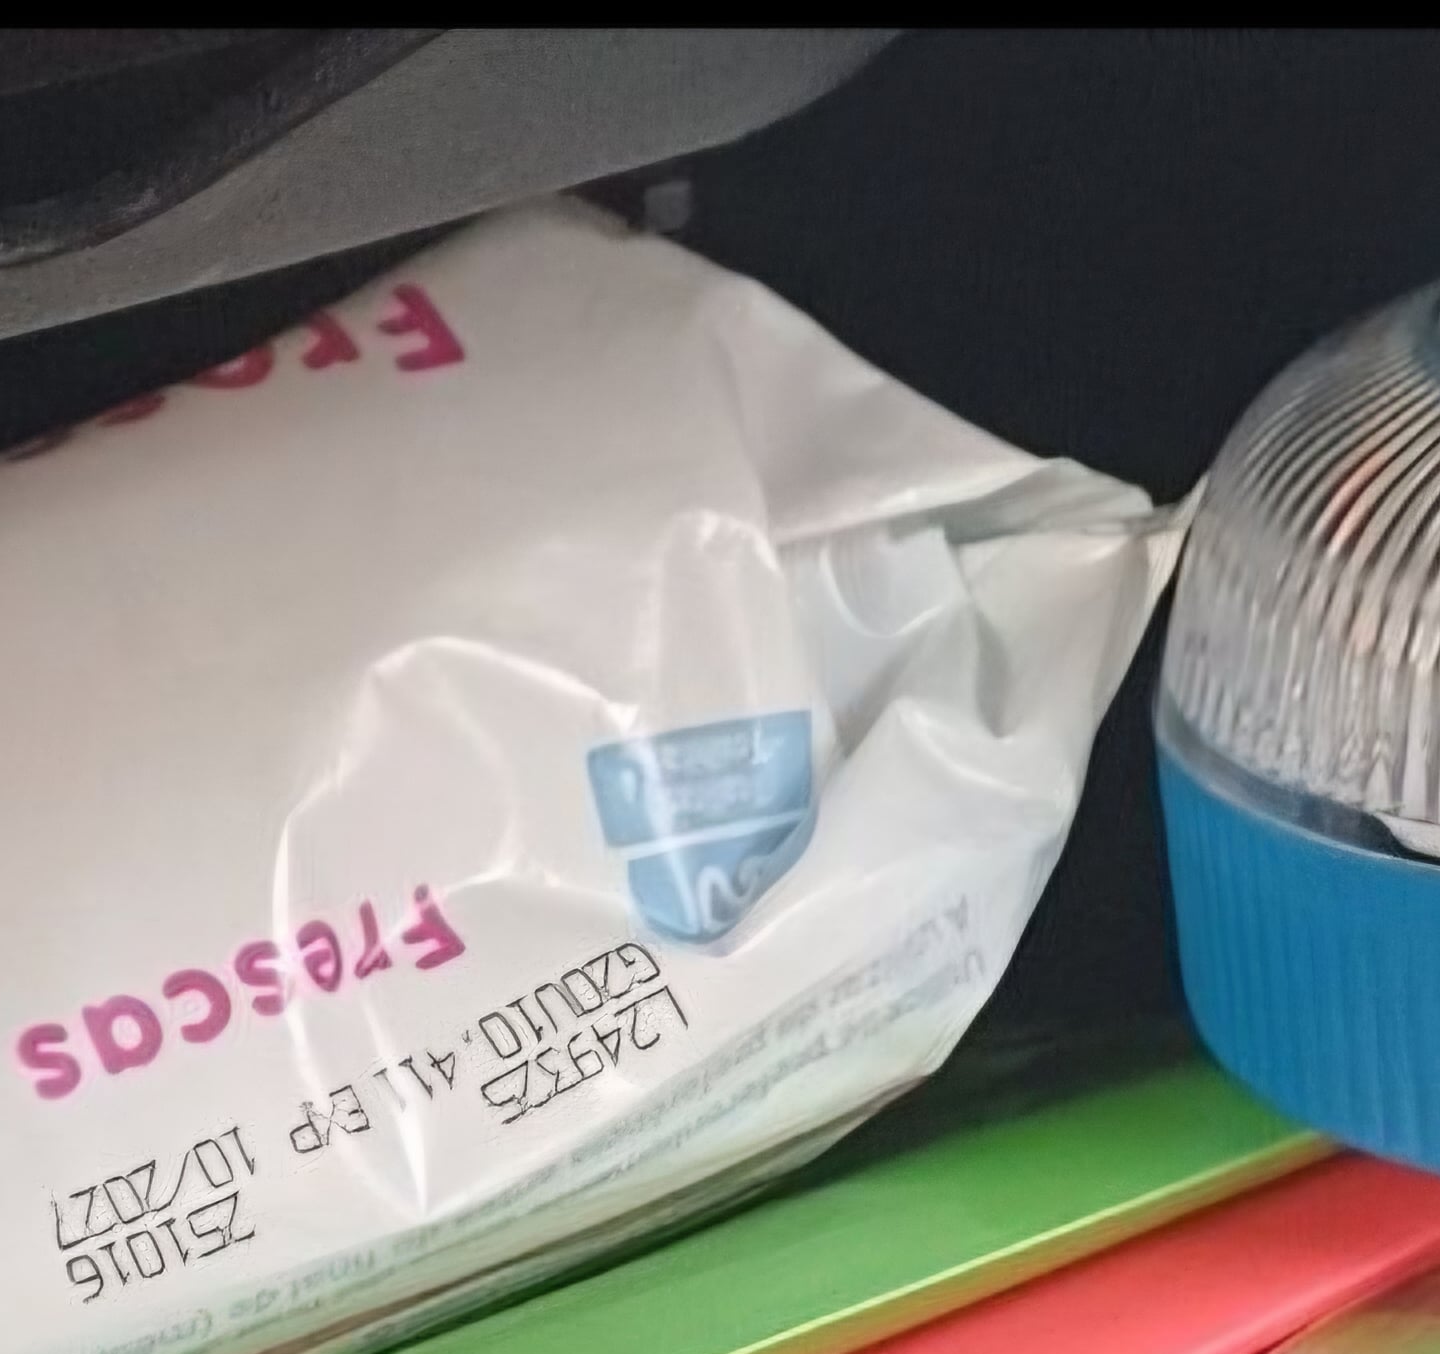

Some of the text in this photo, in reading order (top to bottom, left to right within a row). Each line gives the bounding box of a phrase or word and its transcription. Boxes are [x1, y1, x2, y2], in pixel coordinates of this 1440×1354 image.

[17, 885, 466, 1099] Frescas
[289, 1085, 370, 1154] EXP
[51, 1126, 256, 1250] 10/2027
